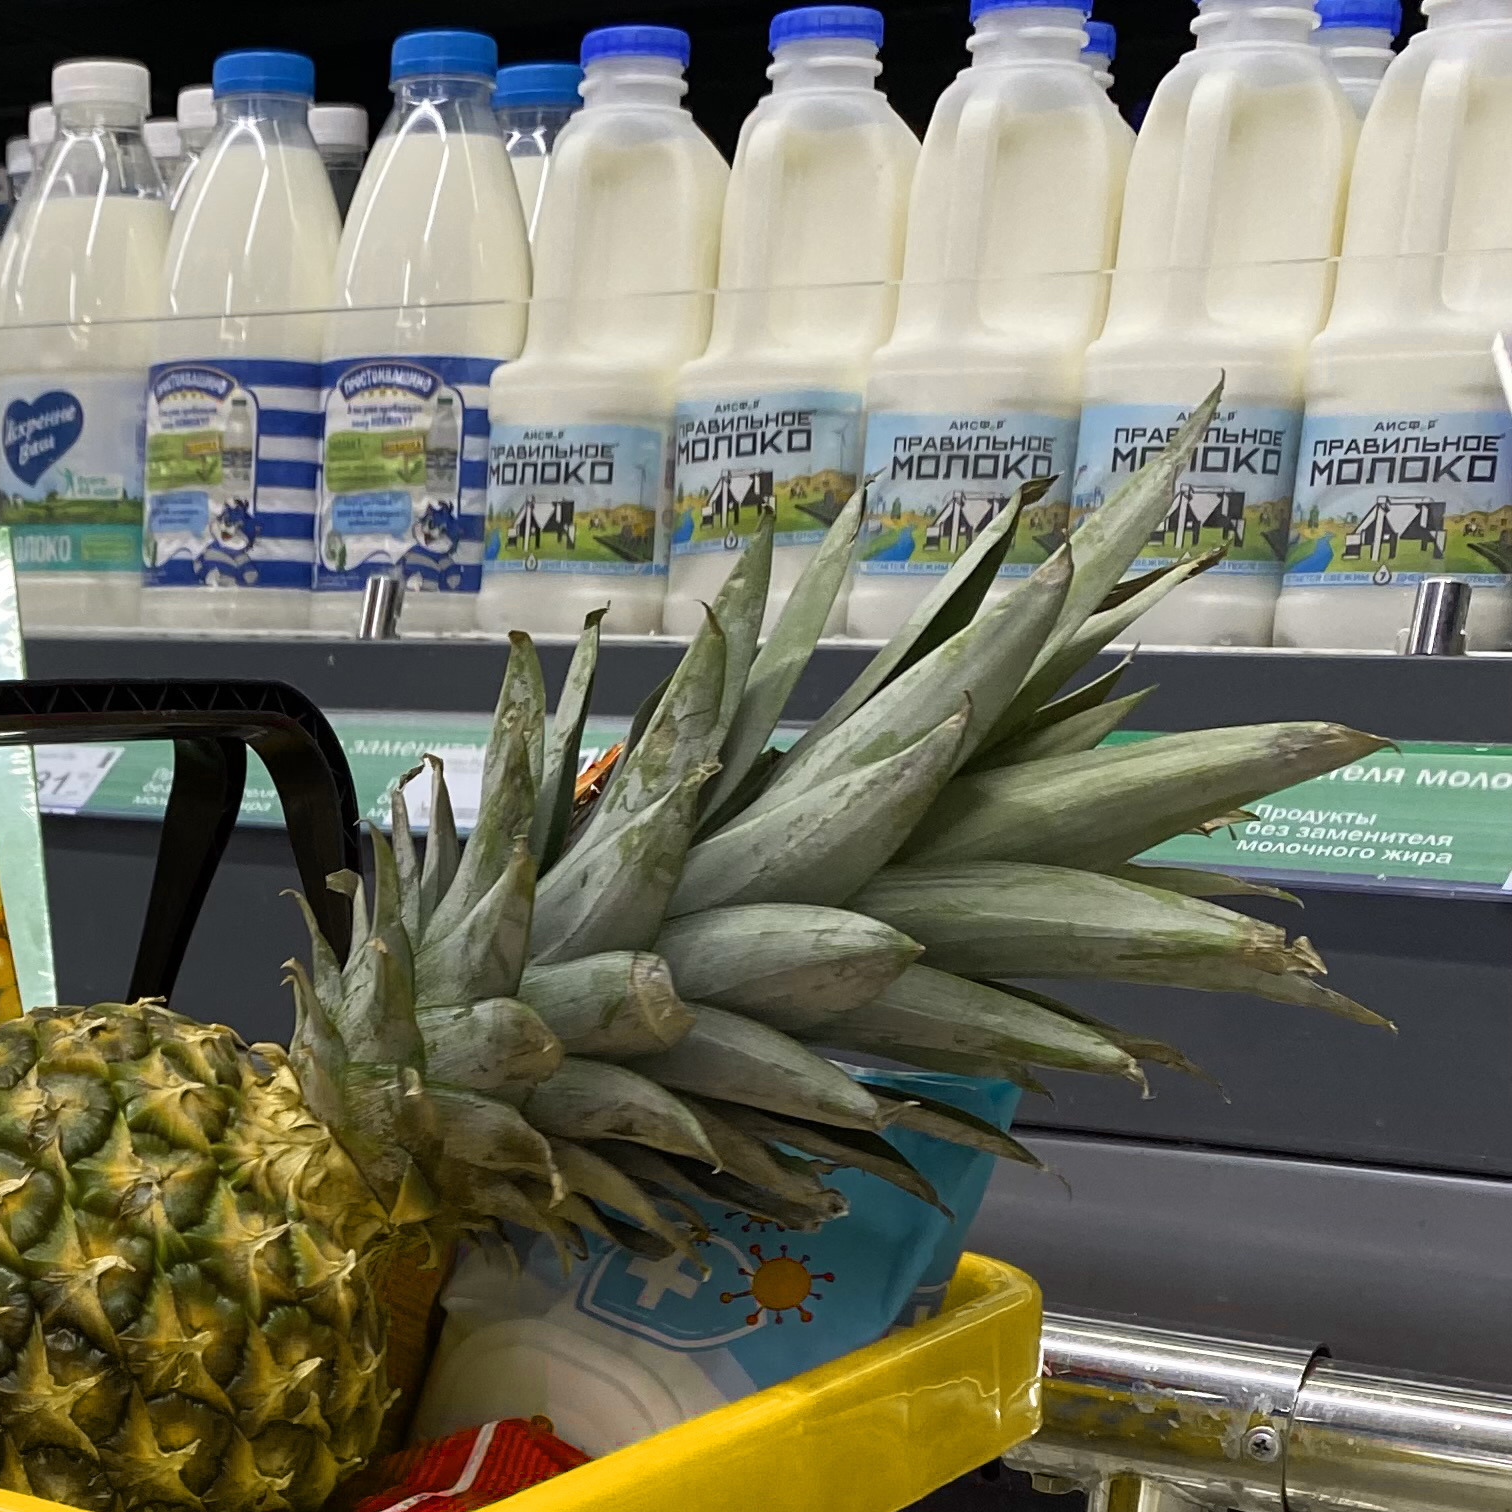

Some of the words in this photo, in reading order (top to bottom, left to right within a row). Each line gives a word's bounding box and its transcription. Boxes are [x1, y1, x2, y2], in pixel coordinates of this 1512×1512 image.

[678, 411, 814, 439] ПРАВИЛЬНОЕ
[1114, 427, 1283, 447] ПРАВЛЬНОЕ
[491, 443, 615, 460] ПРАВИЛЬНОЕ
[677, 429, 813, 466] МОЛОКО
[893, 434, 1053, 453] ПРАВИЛЬНОЕ
[1313, 434, 1501, 457] ПРАВИЛЬНОЕ
[489, 461, 615, 487] МОЛОКО
[891, 453, 1053, 480] МОЛОКО
[1309, 455, 1498, 487] МОЛОКО
[1253, 804, 1377, 827] Продукты
[1245, 821, 1290, 838] без
[1295, 826, 1454, 848] заменителя
[1235, 839, 1376, 860] молочного
[1380, 848, 1453, 866] жира
